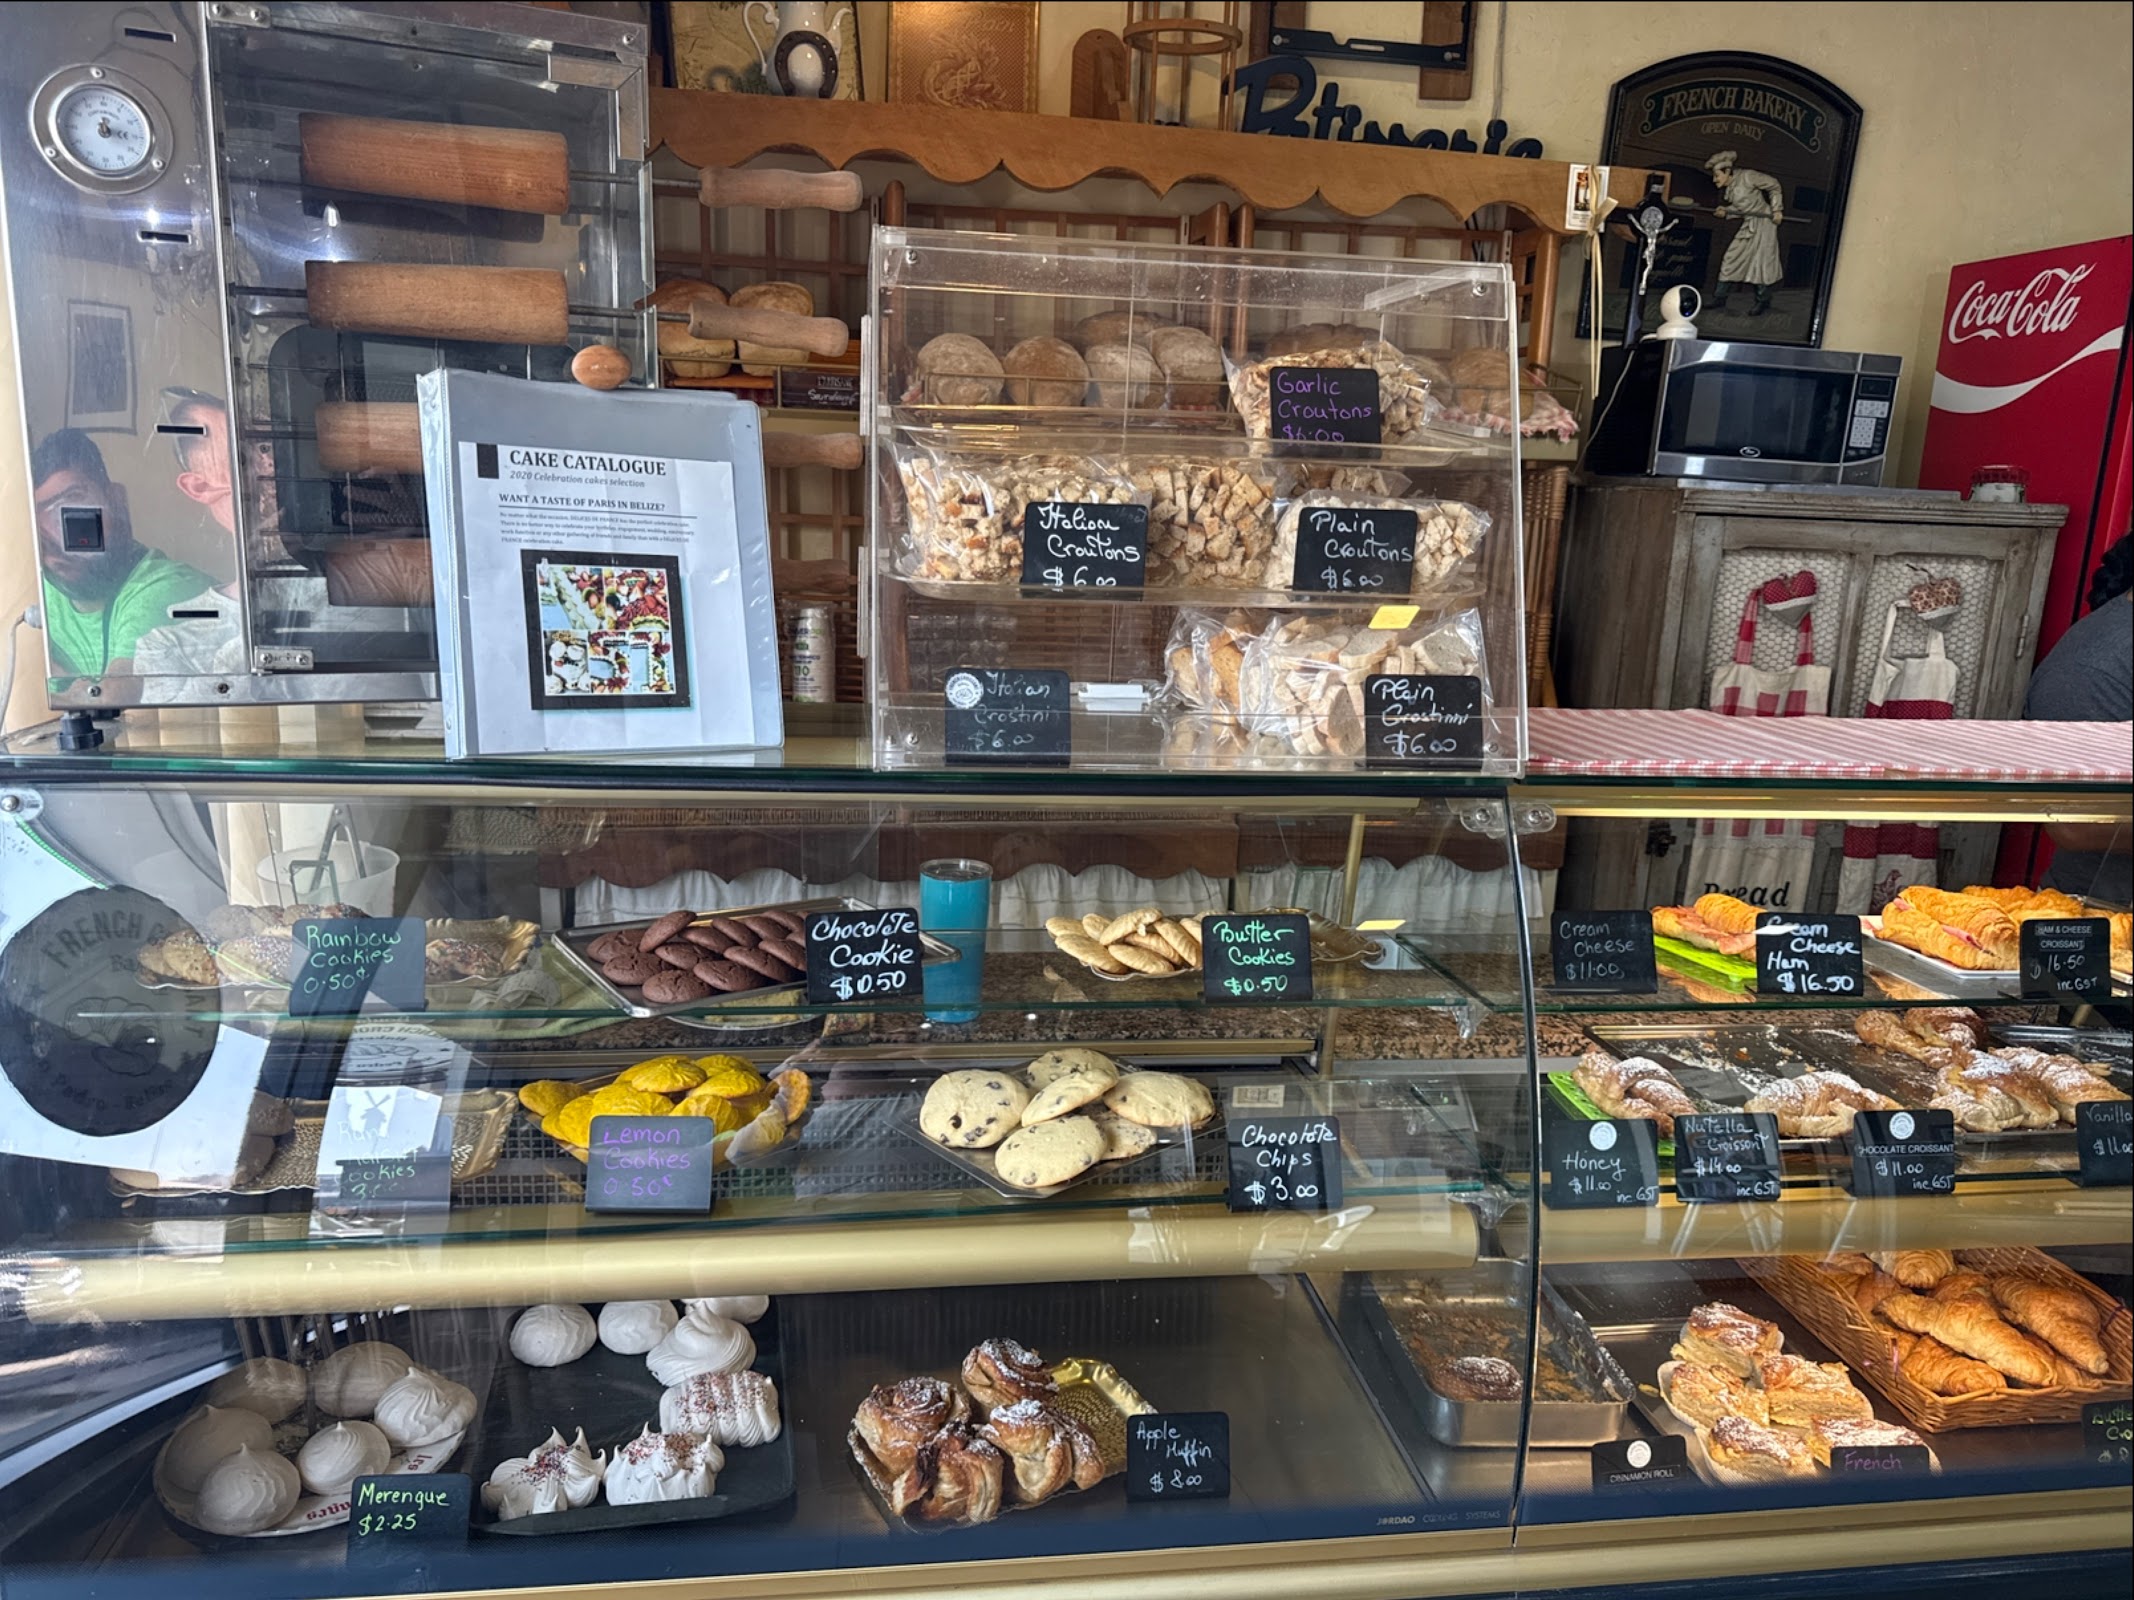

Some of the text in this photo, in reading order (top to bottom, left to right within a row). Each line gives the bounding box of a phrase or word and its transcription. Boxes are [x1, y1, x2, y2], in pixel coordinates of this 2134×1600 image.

[1659, 86, 1807, 131] FRENCH BAKERY
[1701, 120, 1730, 135] OPEN
[1948, 262, 2097, 344] Coca-Cola
[1277, 371, 1341, 395] Garlic
[1277, 398, 1372, 420] Croutons
[509, 449, 667, 476] CAKE CATALOGUE
[510, 470, 645, 489] 2020 Celebration cakes selection
[499, 493, 666, 512] WANT A TASTE OF PARIS IN BELIZE?
[1310, 510, 1375, 535] Plain
[1047, 532, 1140, 562] Croutons
[1324, 536, 1413, 562] Croutons
[1042, 566, 1117, 592] $600
[1372, 678, 1435, 705] Plain
[1383, 730, 1458, 758] $6.00
[1212, 920, 1295, 944] Butter
[1560, 920, 1610, 939] Cream
[1765, 915, 1828, 937] Ceam
[2055, 926, 2061, 934] &
[2061, 925, 2092, 934] CHEESE
[41, 909, 145, 969] FRENCH
[305, 925, 402, 950] Rainbow
[1574, 939, 1635, 957] Cheese
[1790, 938, 1860, 955] Cheese
[2040, 940, 2084, 949] CROISSANT
[310, 949, 394, 968] Cookies
[829, 938, 915, 969] Cookie
[1228, 946, 1296, 966] Cookies
[1767, 951, 1809, 971] Ham
[829, 970, 907, 1001] $0.50
[1223, 975, 1288, 996] $0.50
[1776, 972, 1855, 993] $16.50
[2086, 1103, 2133, 1123] Vanilla
[603, 1127, 680, 1144] Lemon
[1685, 1116, 1754, 1133] Nutella
[604, 1147, 691, 1170] Cookies
[1907, 1143, 1954, 1154] CROISSANT
[1256, 1149, 1312, 1175] Chips
[1562, 1150, 1627, 1181] Honey
[1136, 1420, 1181, 1451] Apple
[1844, 1450, 1903, 1472] French
[1608, 1468, 1675, 1483] CINNAMON ROLL
[358, 1513, 417, 1536] $2.25
[1465, 1510, 1501, 1521] SYSTEMS
